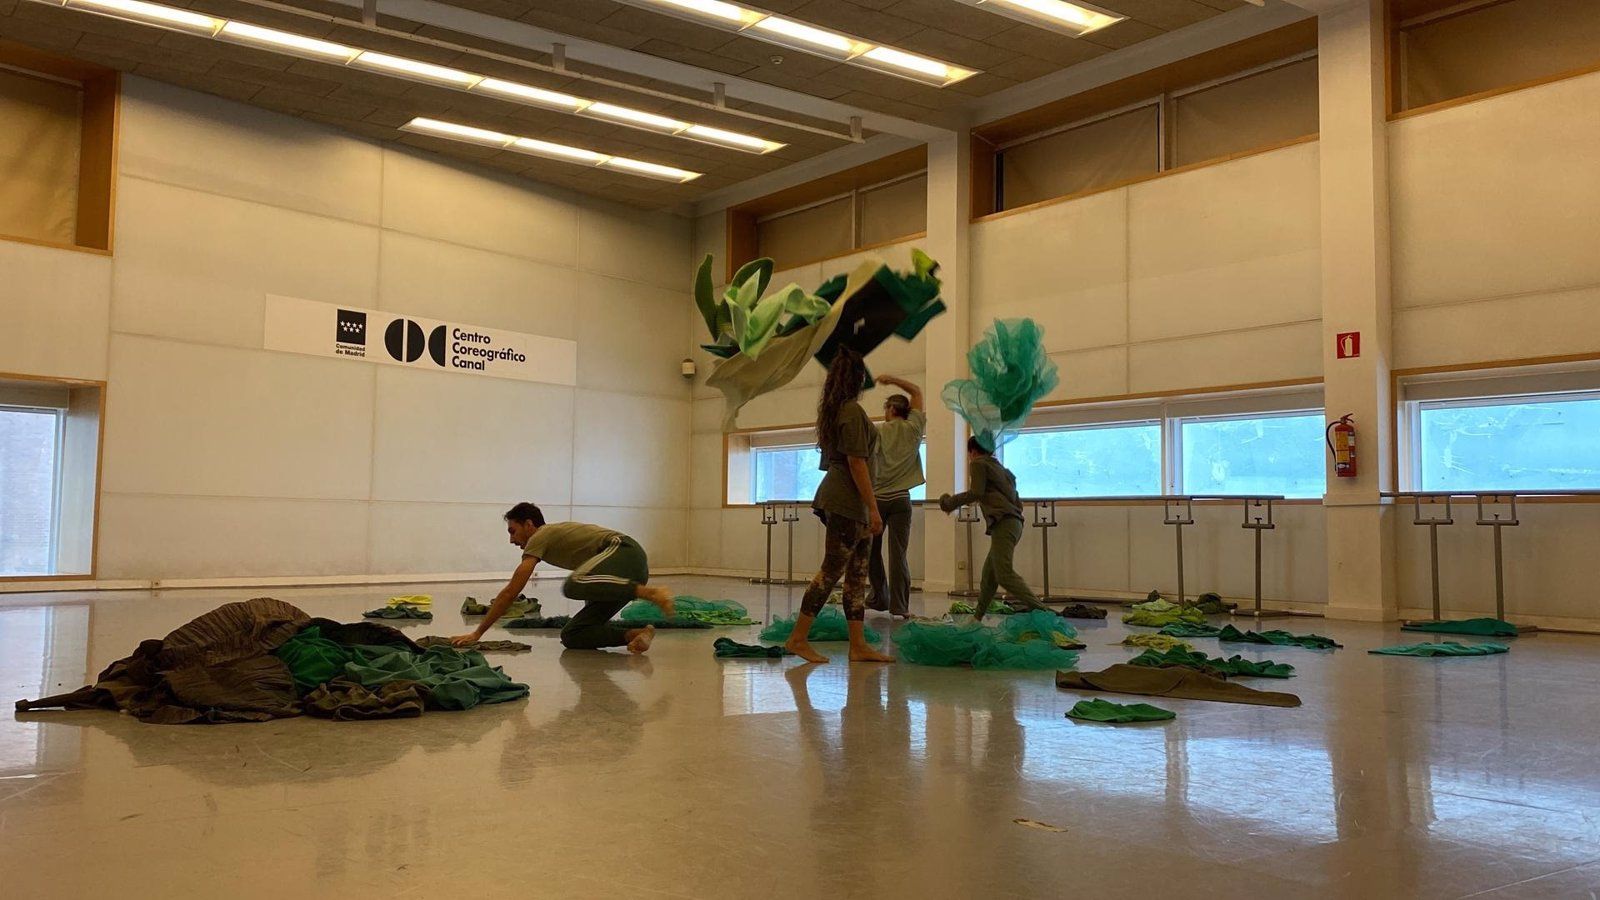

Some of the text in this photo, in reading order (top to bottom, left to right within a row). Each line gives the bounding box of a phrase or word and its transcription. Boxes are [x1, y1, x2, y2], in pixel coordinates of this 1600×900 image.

[452, 328, 491, 344] Centro
[335, 343, 366, 352] Comunidad
[344, 350, 366, 358] Madrid
[452, 342, 526, 362] Coreográfico
[452, 356, 486, 371] Canal
